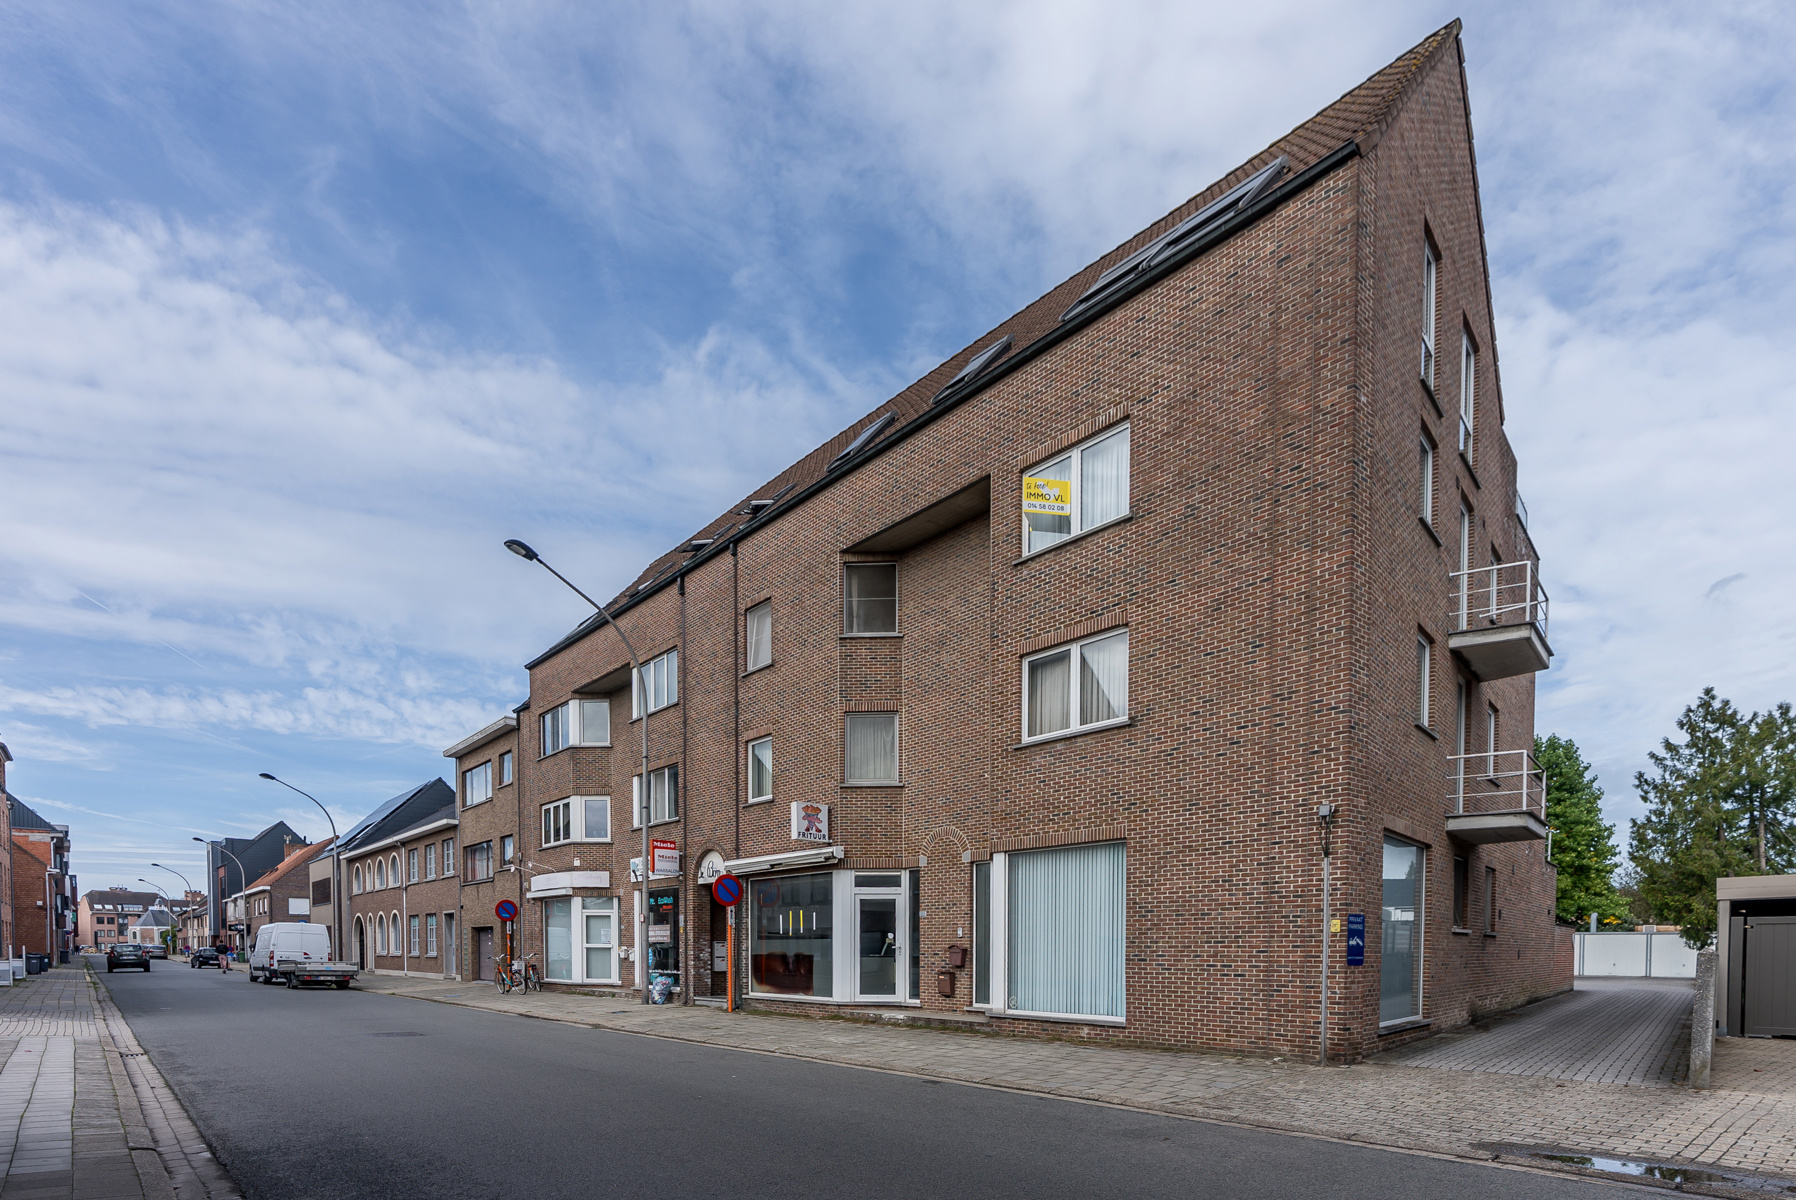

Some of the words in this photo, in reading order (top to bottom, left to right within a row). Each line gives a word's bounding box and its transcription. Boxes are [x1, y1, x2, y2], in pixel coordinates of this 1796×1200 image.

[1026, 491, 1051, 501] IMMO
[1053, 494, 1065, 502] VL
[797, 831, 827, 840] FRITUUR
